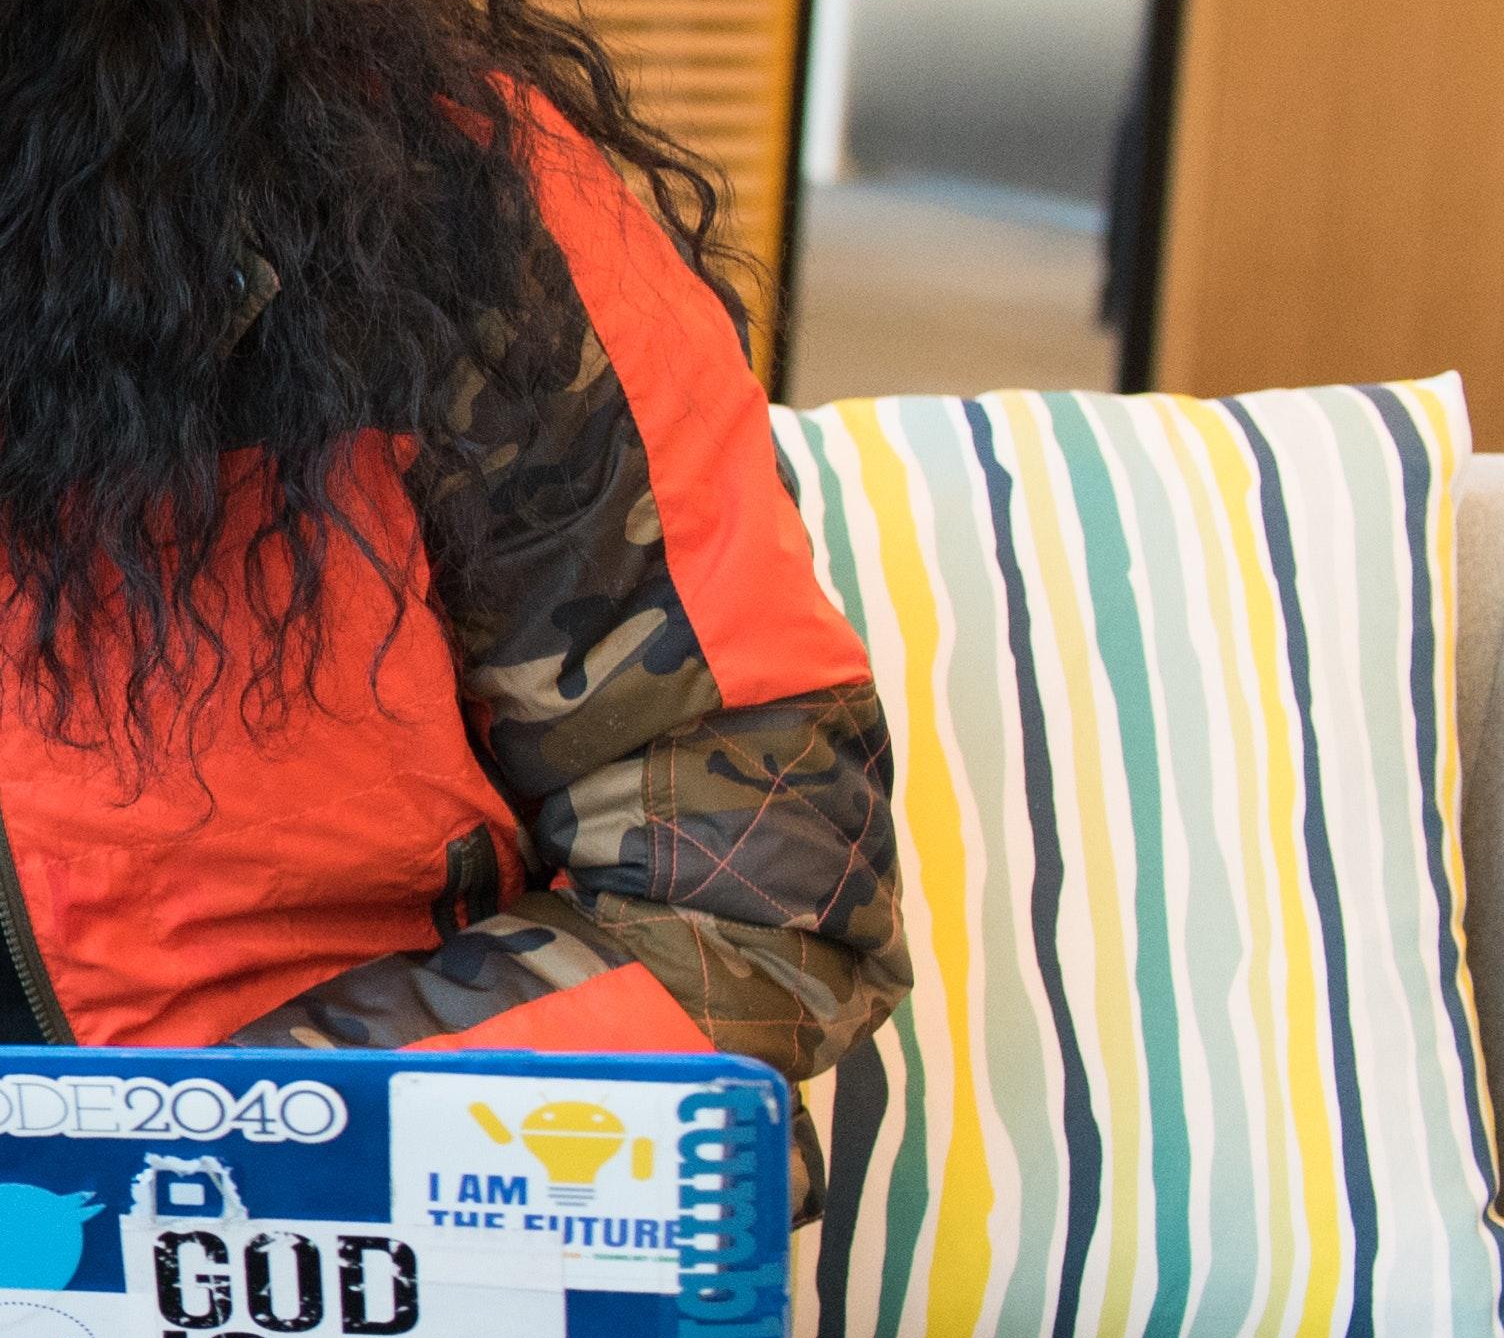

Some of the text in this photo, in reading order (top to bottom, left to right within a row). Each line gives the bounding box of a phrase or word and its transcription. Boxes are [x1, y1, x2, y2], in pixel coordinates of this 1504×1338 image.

[428, 1172, 529, 1206] I AM
[154, 1229, 420, 1336] GOD
